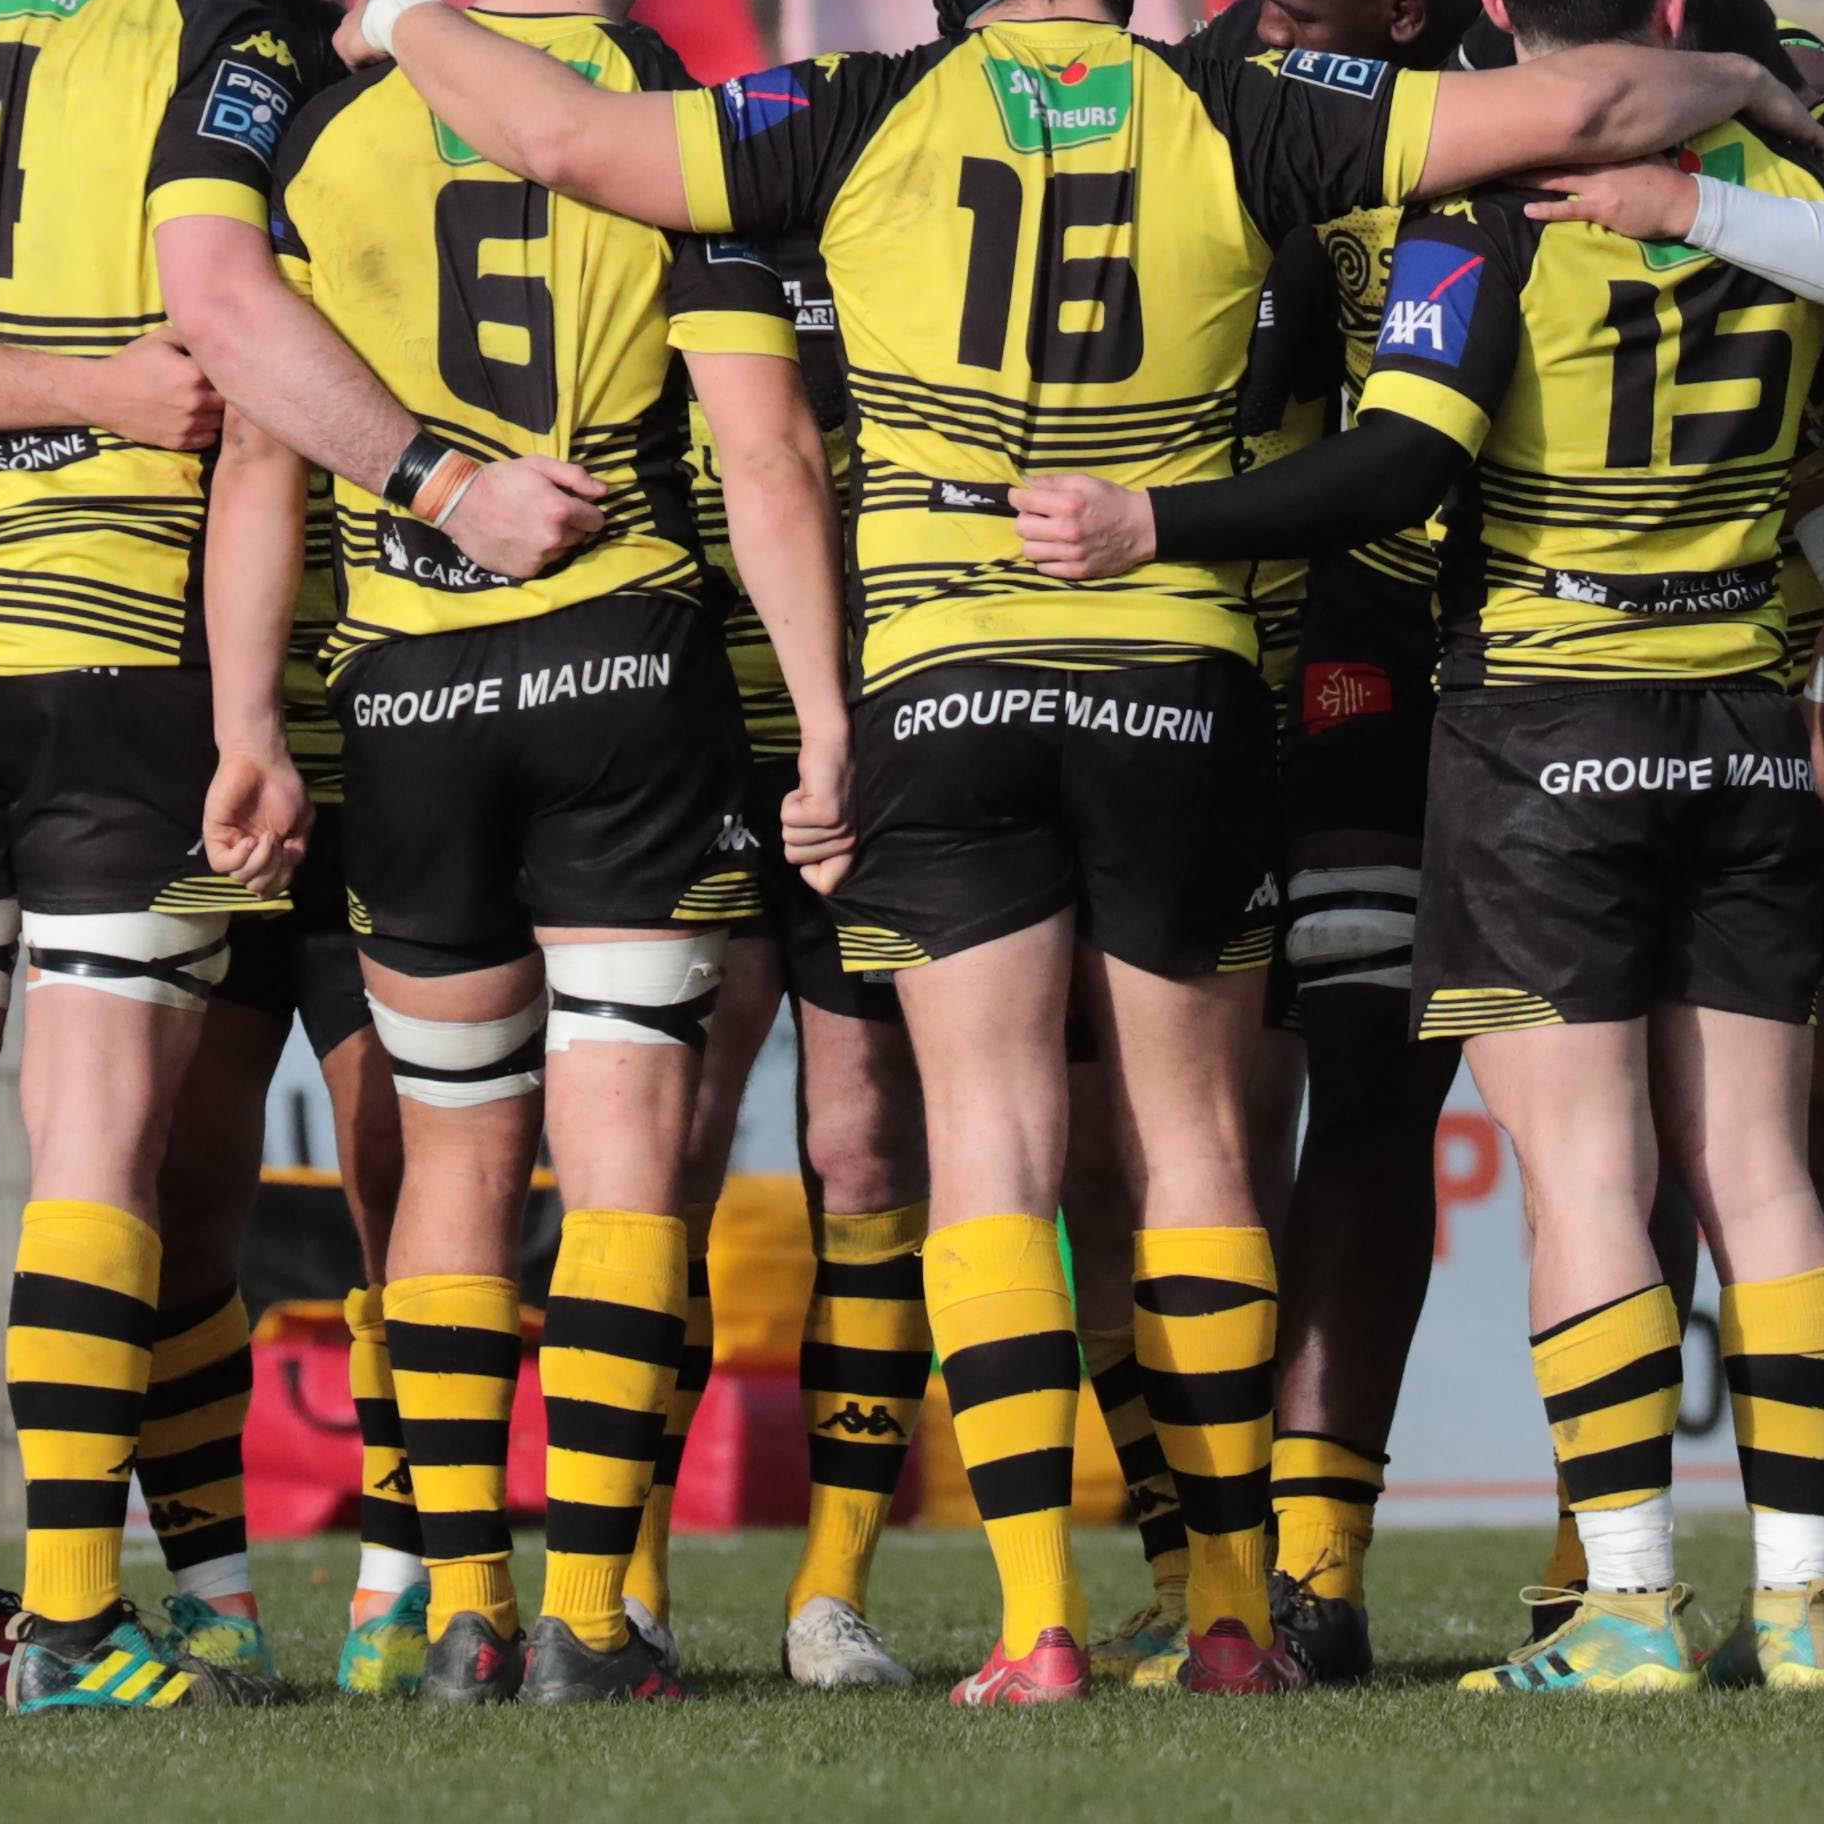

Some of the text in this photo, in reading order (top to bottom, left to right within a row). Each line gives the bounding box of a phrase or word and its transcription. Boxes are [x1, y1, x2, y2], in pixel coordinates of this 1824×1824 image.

[227, 72, 288, 116] PRO
[213, 103, 277, 156] D2
[957, 156, 1144, 384] 16
[435, 179, 558, 435] 6
[1376, 301, 1444, 351] AXA
[1603, 266, 1793, 468] 15
[354, 653, 670, 727] GROUPE MAURIN
[894, 689, 1214, 744] GROUPE MAURIN
[1539, 757, 1713, 795] GROUPE
